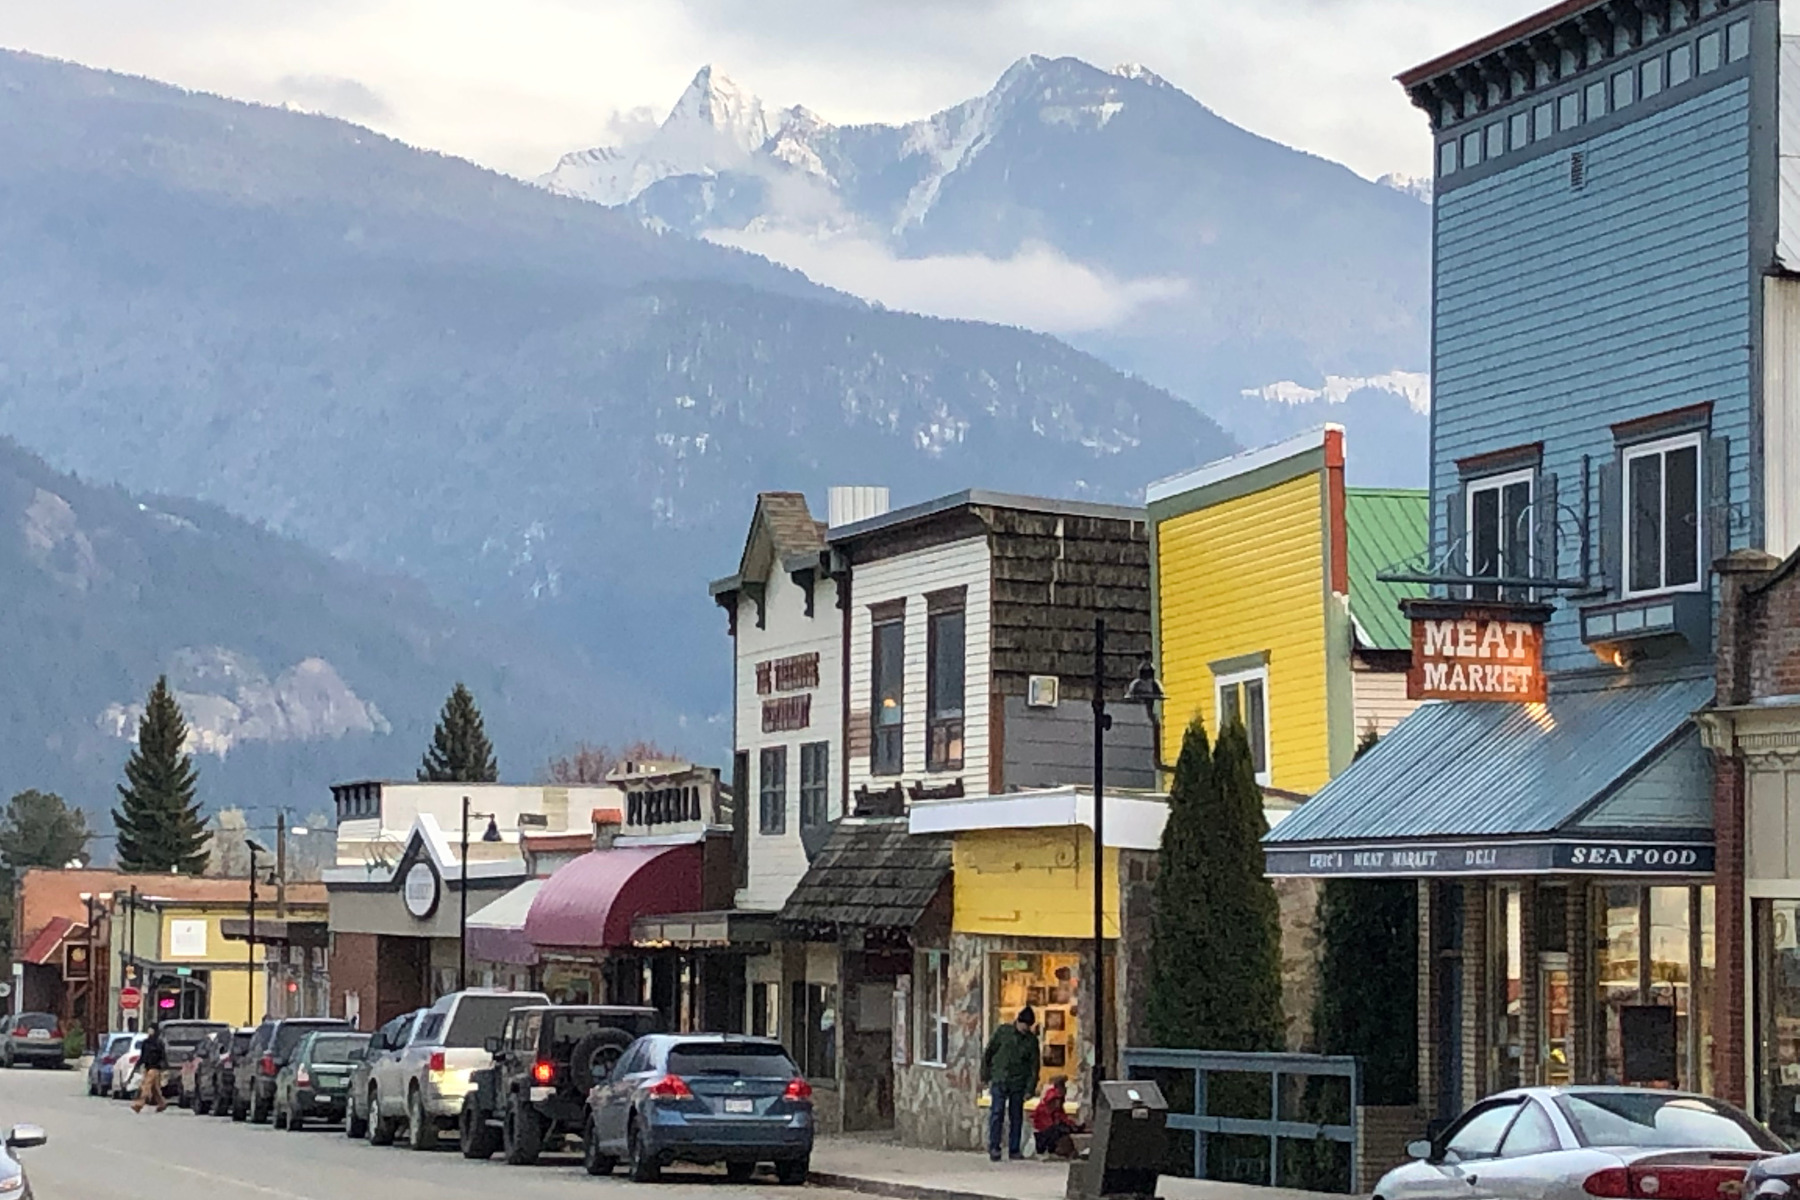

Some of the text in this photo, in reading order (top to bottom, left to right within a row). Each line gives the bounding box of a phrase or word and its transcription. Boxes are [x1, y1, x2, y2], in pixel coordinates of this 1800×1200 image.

[1423, 620, 1532, 658] MEAT
[1423, 662, 1532, 692] MARKET
[1465, 849, 1497, 866] DELI
[1570, 847, 1697, 864] SEAFOOD
